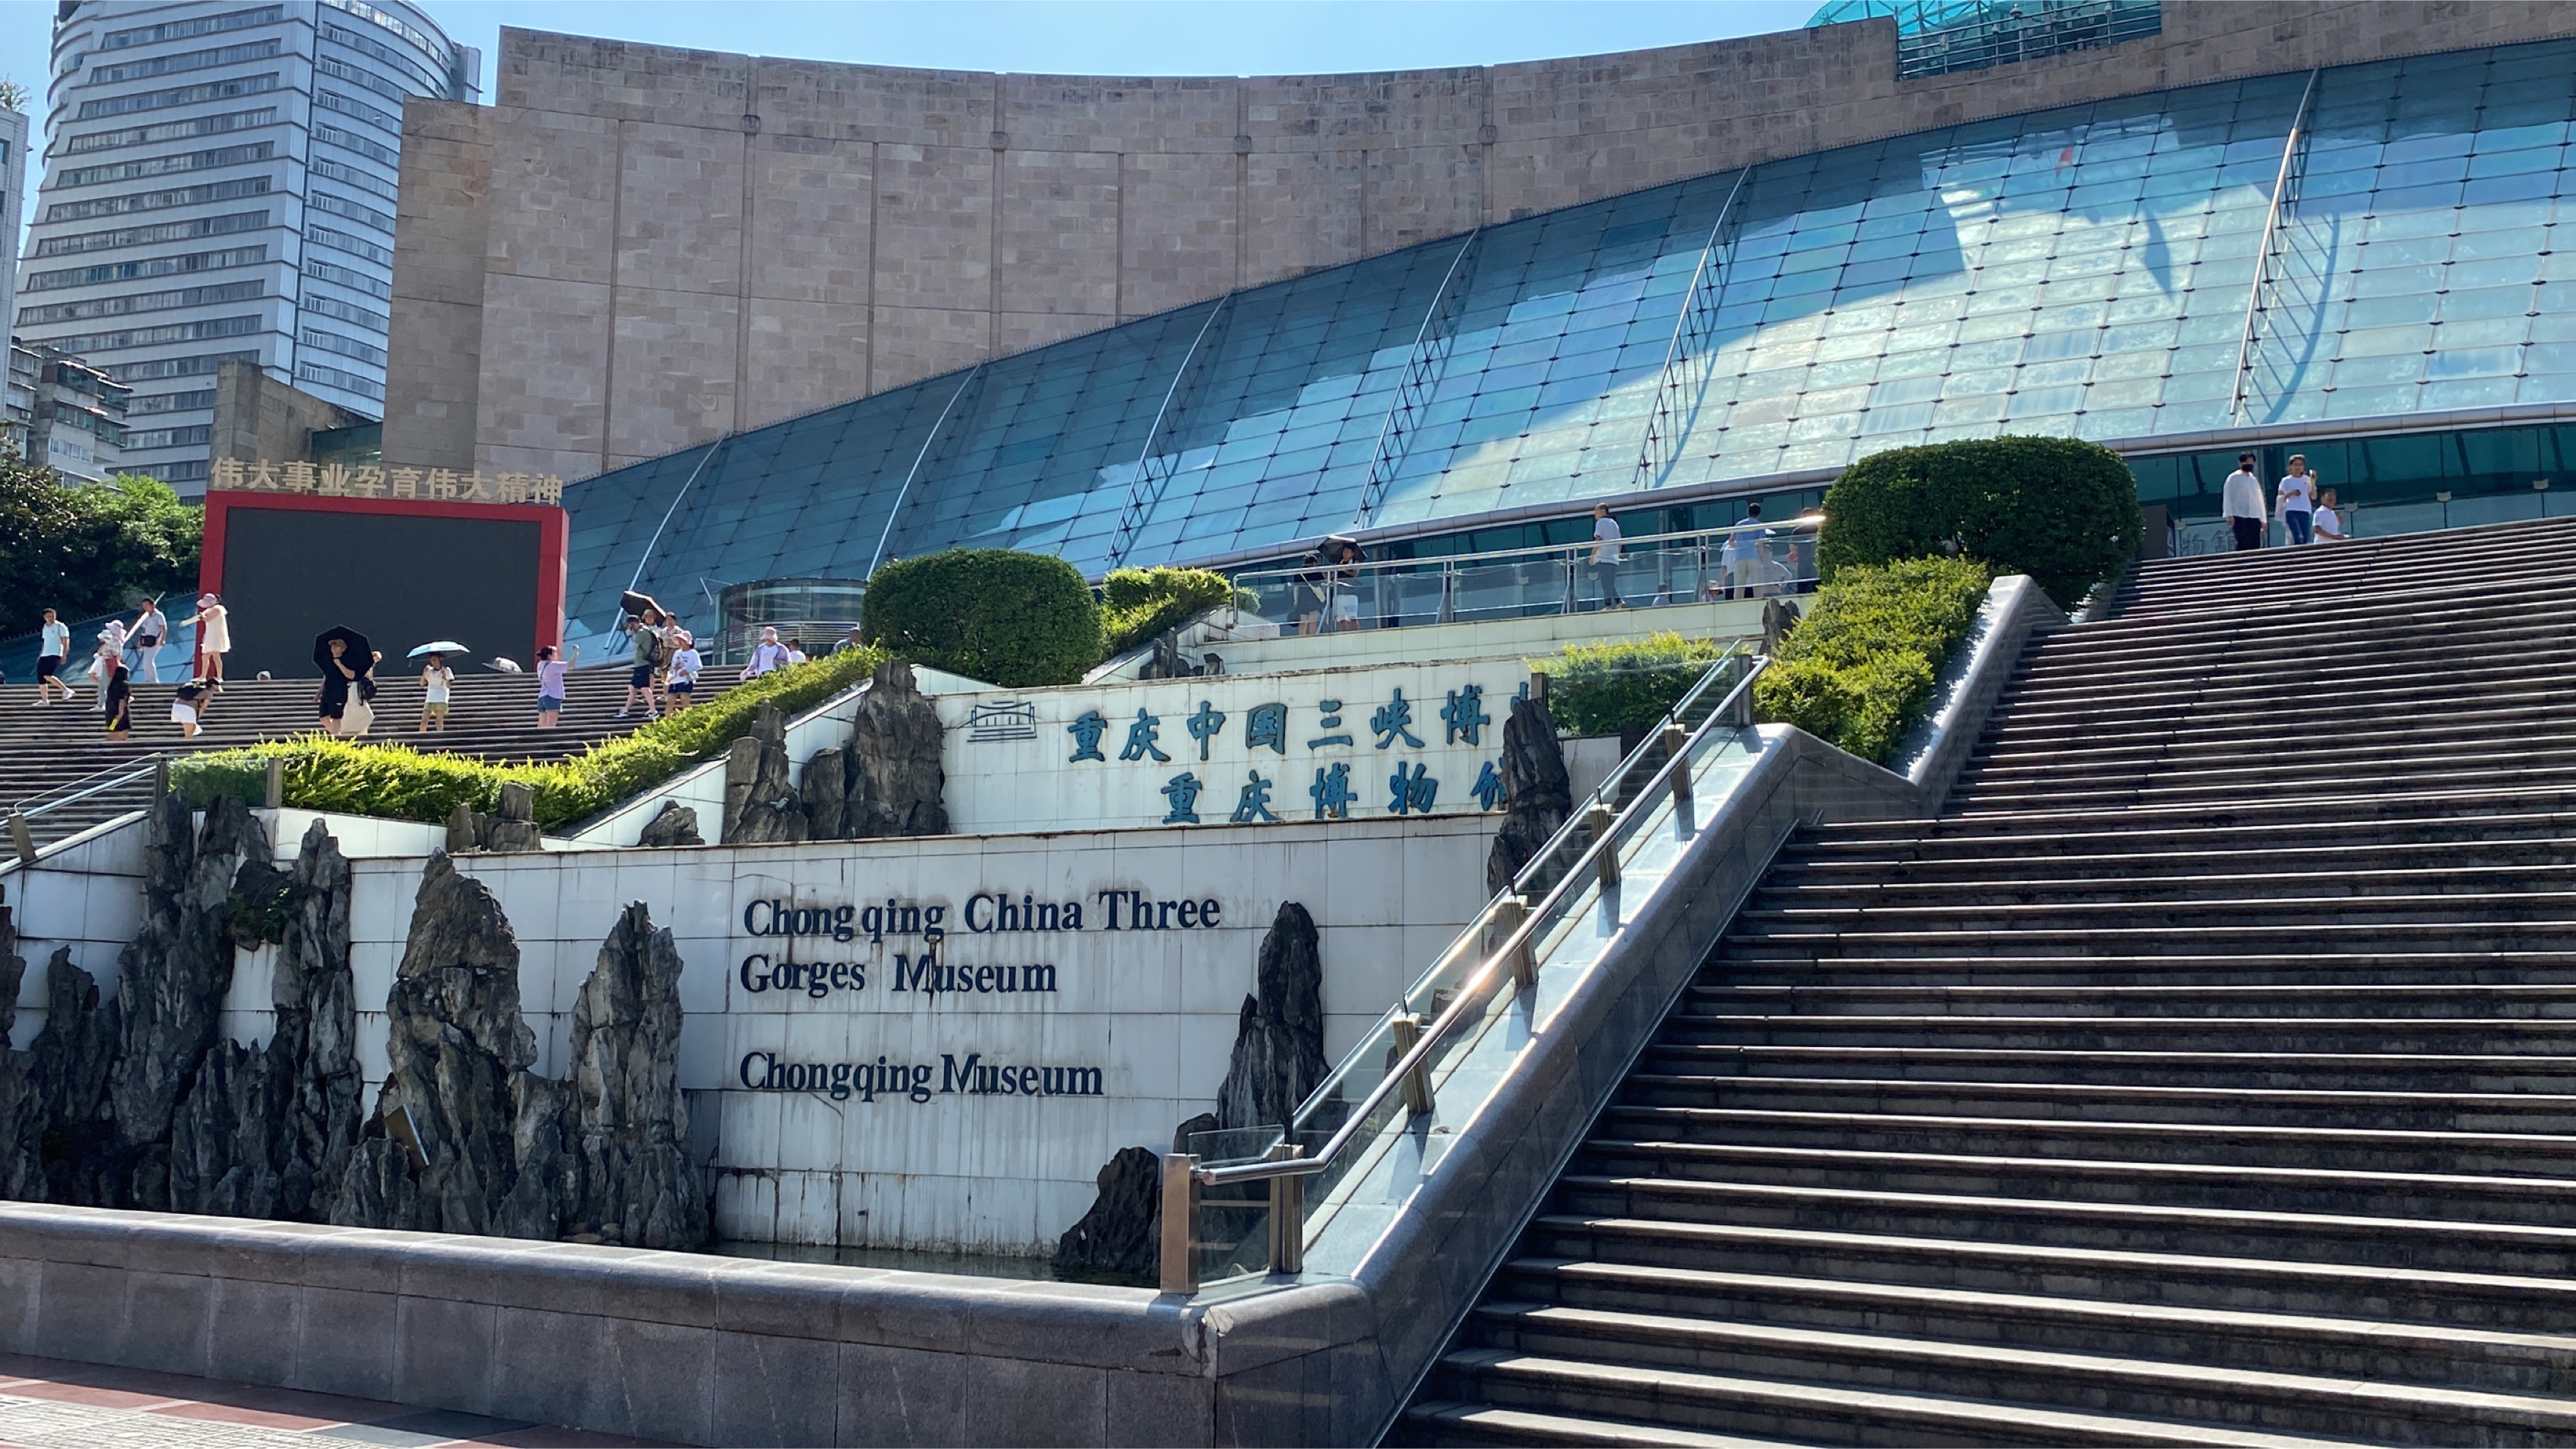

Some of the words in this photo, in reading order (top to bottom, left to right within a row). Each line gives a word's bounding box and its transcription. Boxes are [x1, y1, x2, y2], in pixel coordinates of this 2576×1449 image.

[210, 457, 564, 505] 伟大事业孕育伟大精神
[1067, 681, 1530, 764] 重庆中国三峡博
[744, 898, 946, 943] Chongqing
[964, 893, 1083, 933] China
[1098, 890, 1221, 930] Three
[740, 954, 865, 998] Gorges
[891, 954, 1057, 994] Museum
[739, 1050, 933, 1104] Chongqing
[940, 1053, 1104, 1096] Museum
